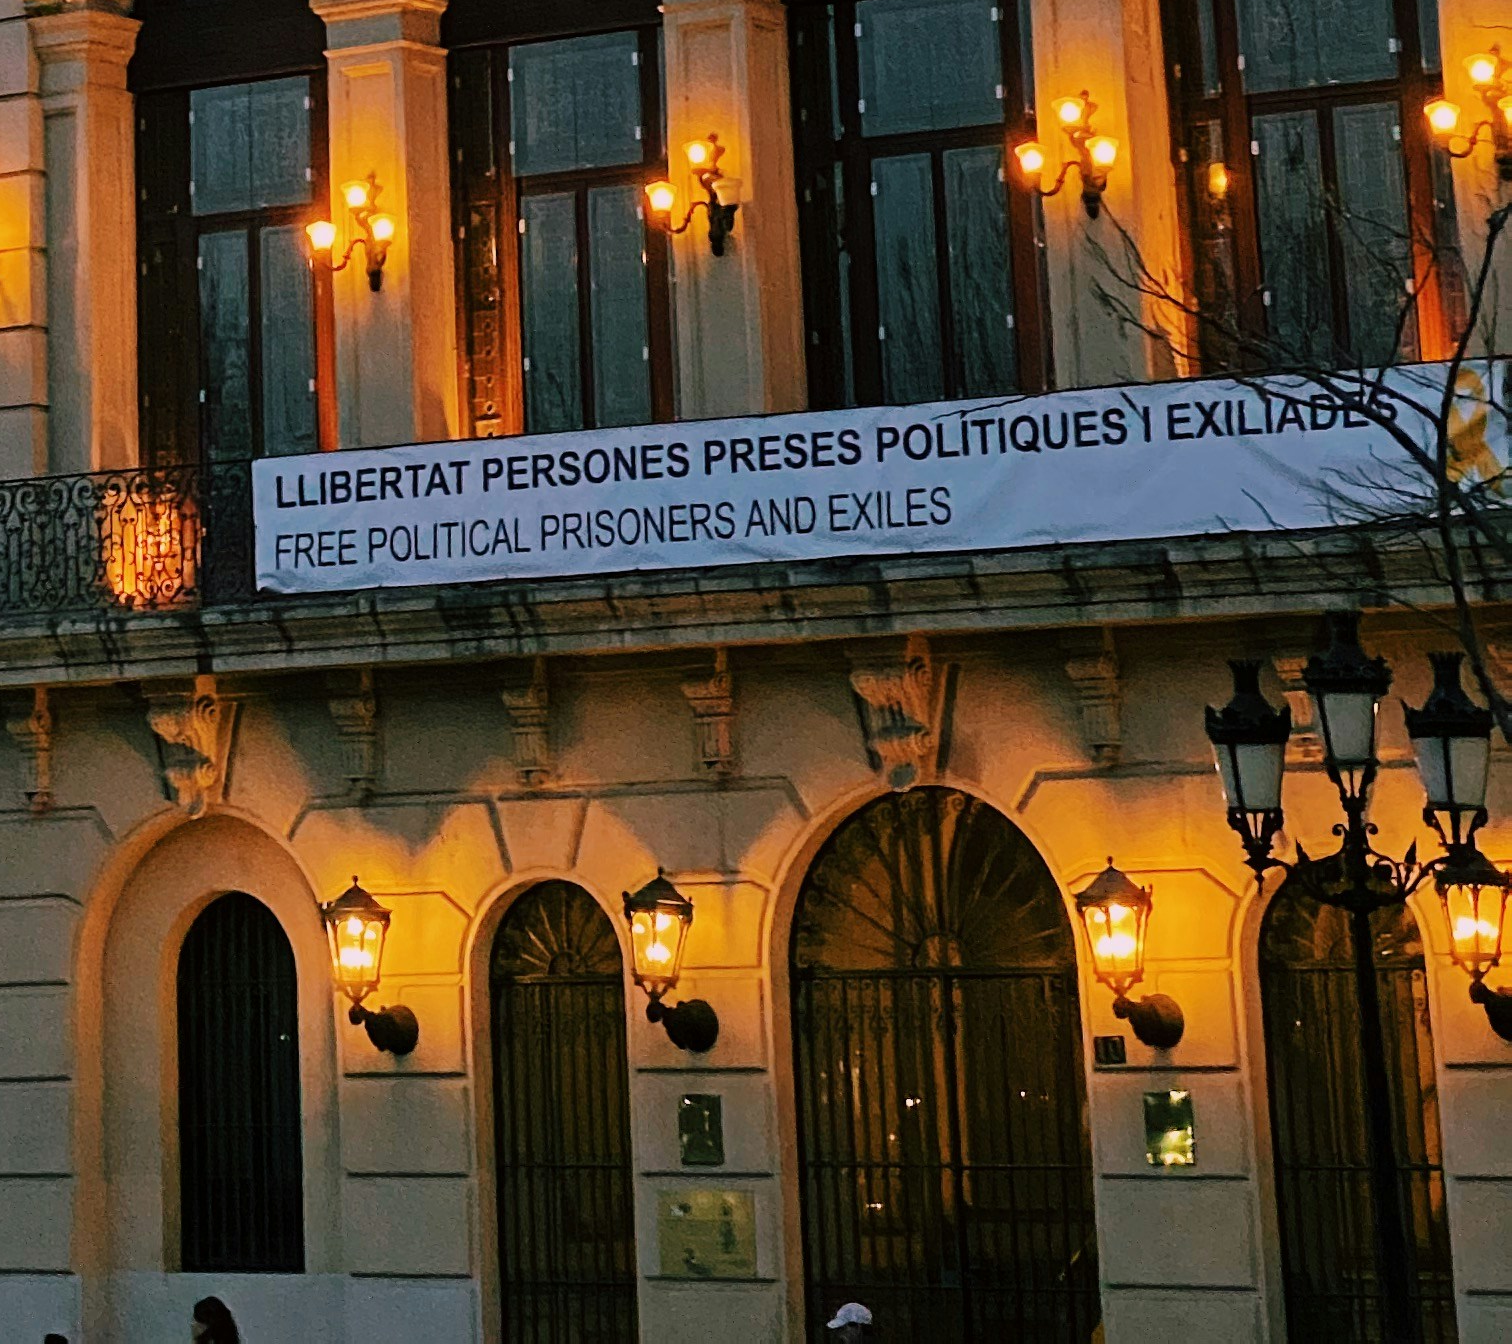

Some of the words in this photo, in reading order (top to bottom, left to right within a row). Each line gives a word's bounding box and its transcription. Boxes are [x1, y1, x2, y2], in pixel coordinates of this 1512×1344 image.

[275, 461, 470, 509] LLIBERTAT
[482, 441, 690, 492] PERSONES
[703, 429, 862, 475] PRESES
[877, 408, 1128, 463] POLITIQUES
[275, 529, 357, 570] FREE
[369, 517, 531, 565] POLITICAL
[540, 501, 736, 551] PRISONERS
[745, 496, 816, 538] AND
[829, 486, 953, 532] EXILES
